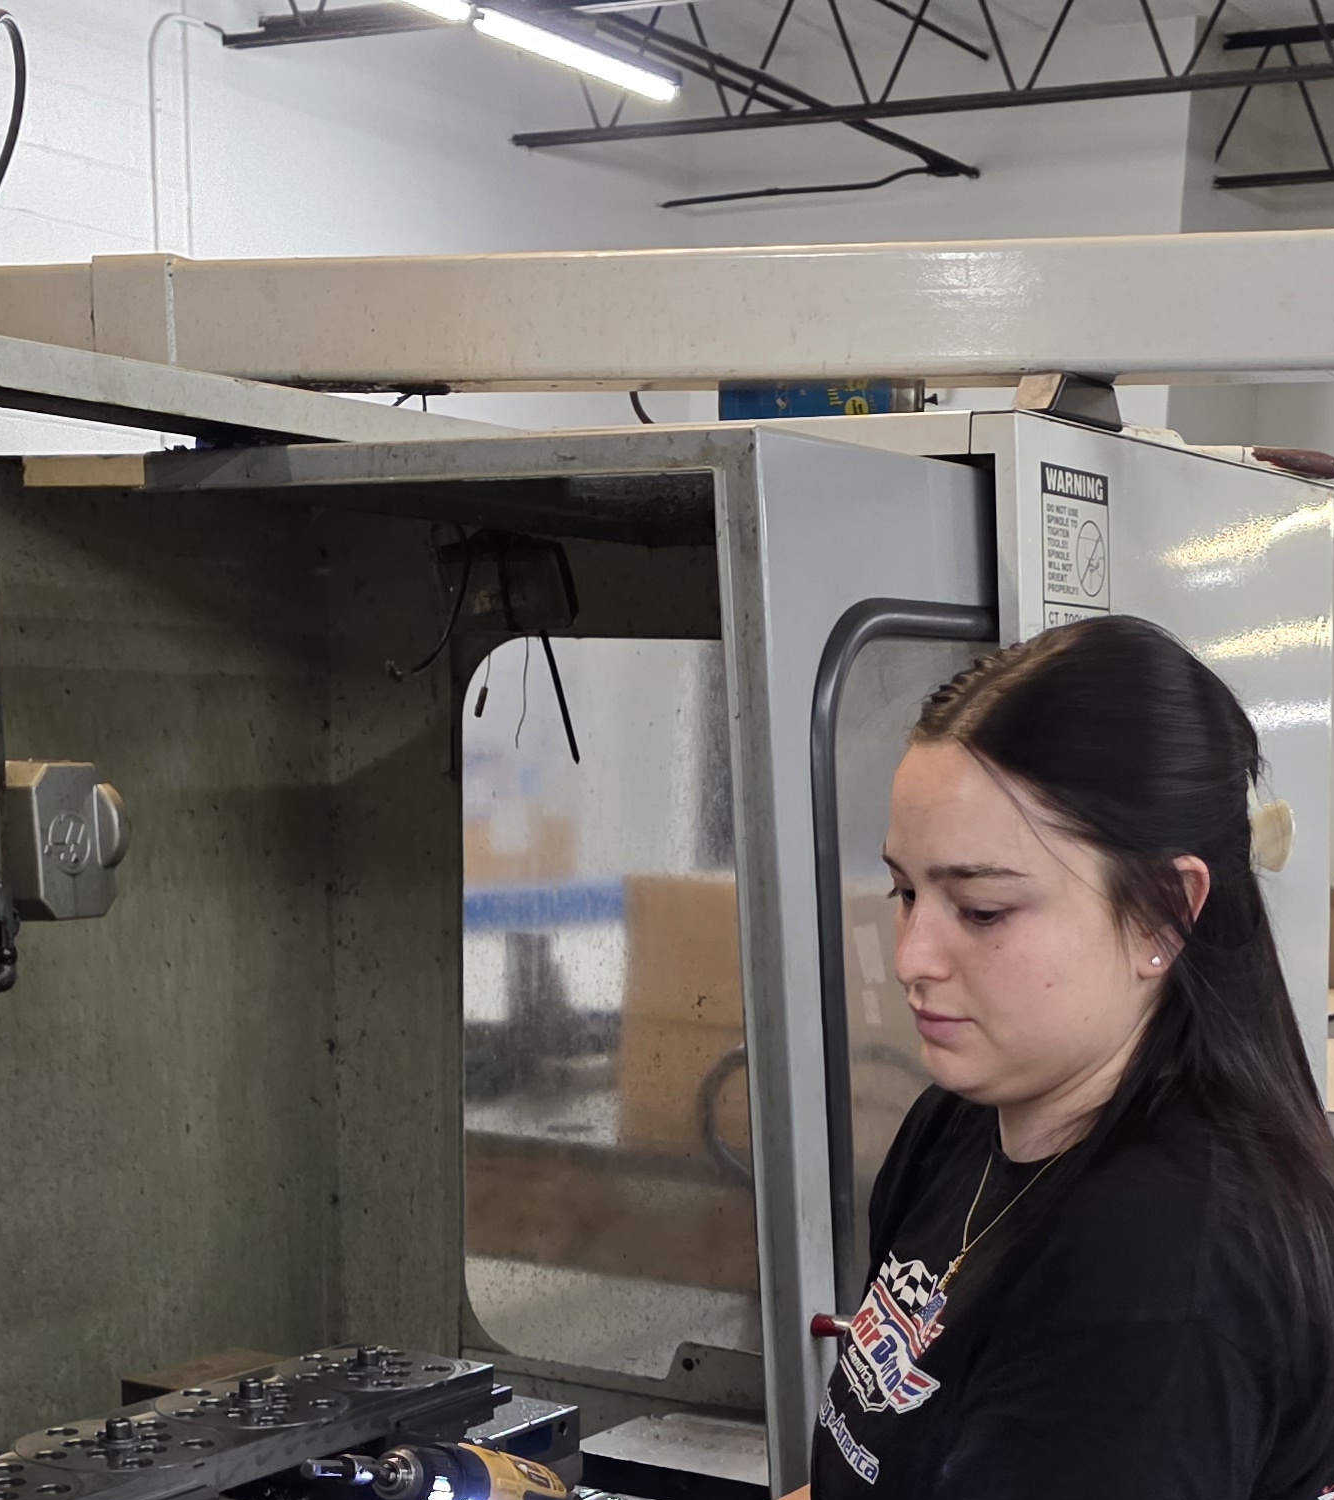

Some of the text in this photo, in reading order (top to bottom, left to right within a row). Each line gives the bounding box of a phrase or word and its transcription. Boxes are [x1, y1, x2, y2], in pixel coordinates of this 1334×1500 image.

[1045, 467, 1104, 501] WARNING
[1047, 503, 1079, 517] DO NOT USE
[1047, 514, 1078, 528] SPINDLE TO
[1047, 525, 1069, 538] TIGHTEN
[1047, 548, 1070, 561] SPINDLE
[1048, 560, 1073, 572] WILL NOT
[1048, 571, 1068, 582] ORIENT
